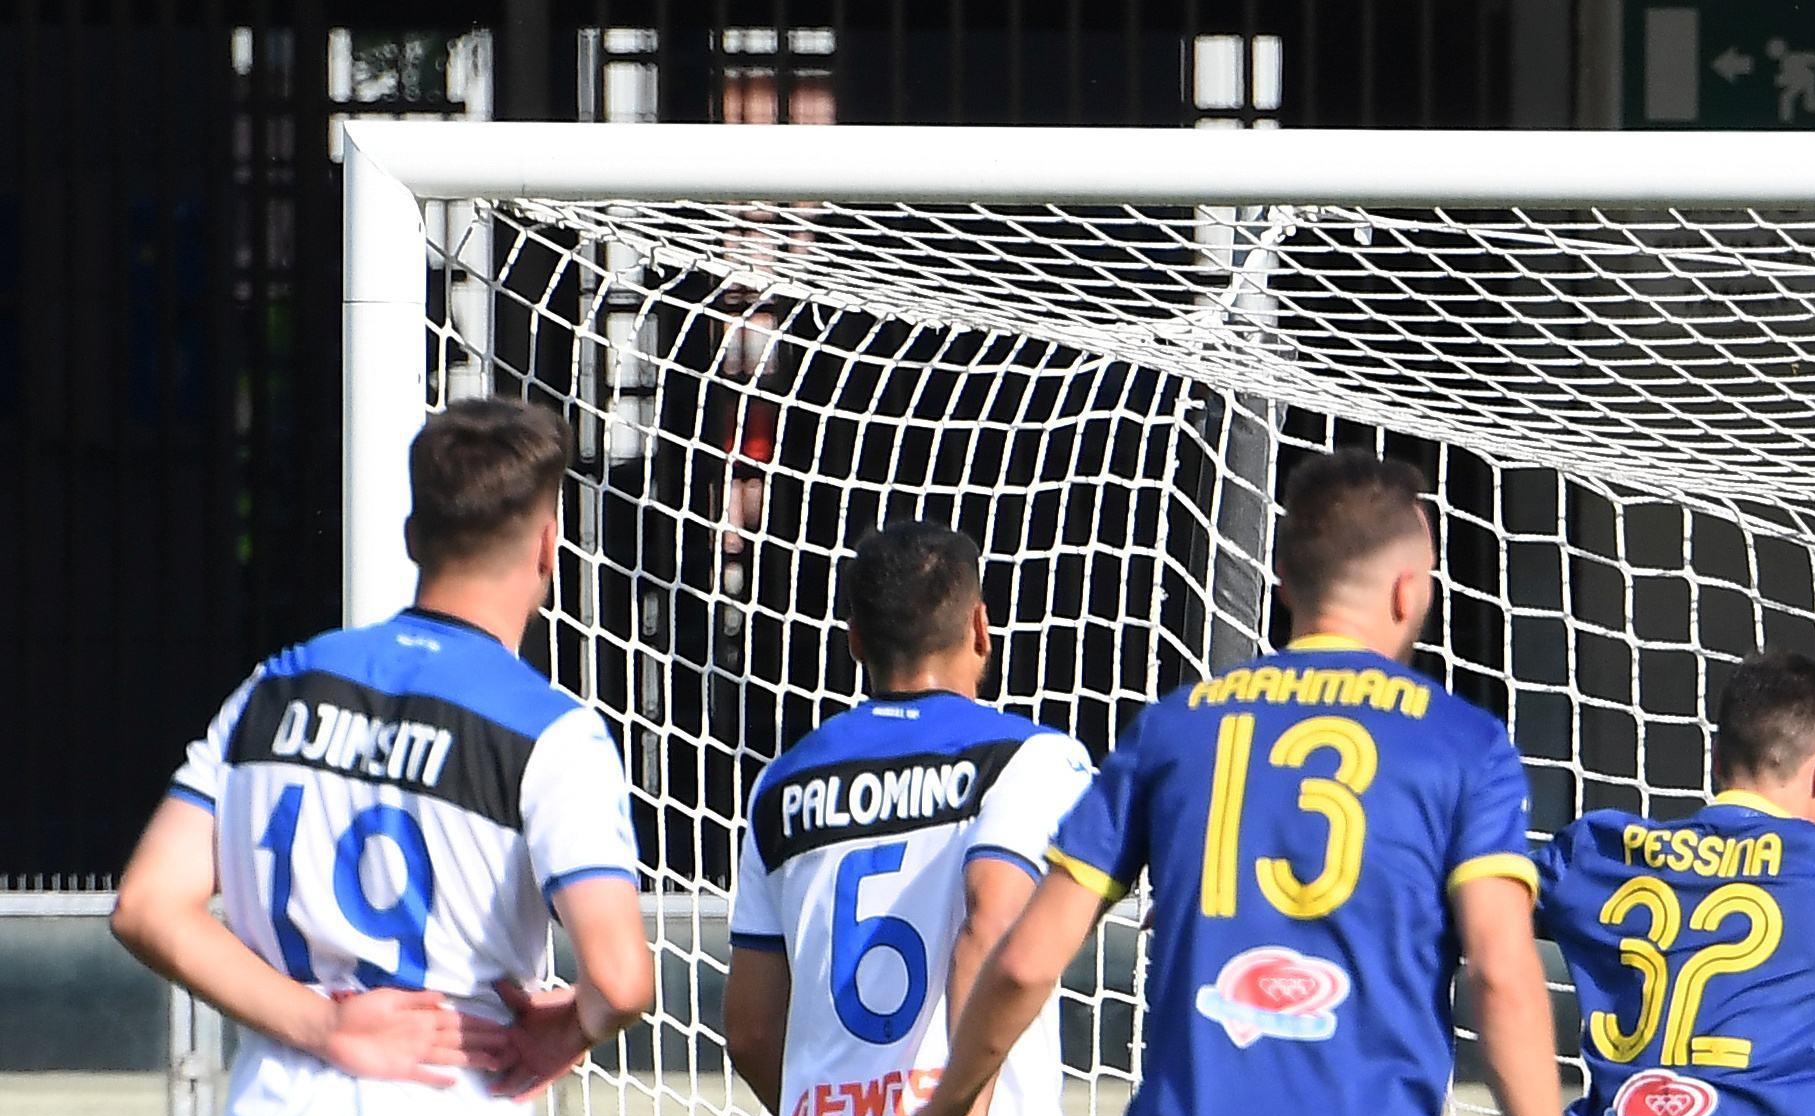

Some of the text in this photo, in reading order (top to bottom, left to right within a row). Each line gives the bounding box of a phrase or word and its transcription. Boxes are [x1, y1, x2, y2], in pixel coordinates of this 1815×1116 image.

[257, 783, 434, 990] 19
[782, 761, 978, 838] PALOMINO
[1201, 712, 1379, 920] 13
[1622, 823, 1783, 878] PESSINA
[830, 842, 928, 1046] 6
[1589, 875, 1784, 1070] 32
